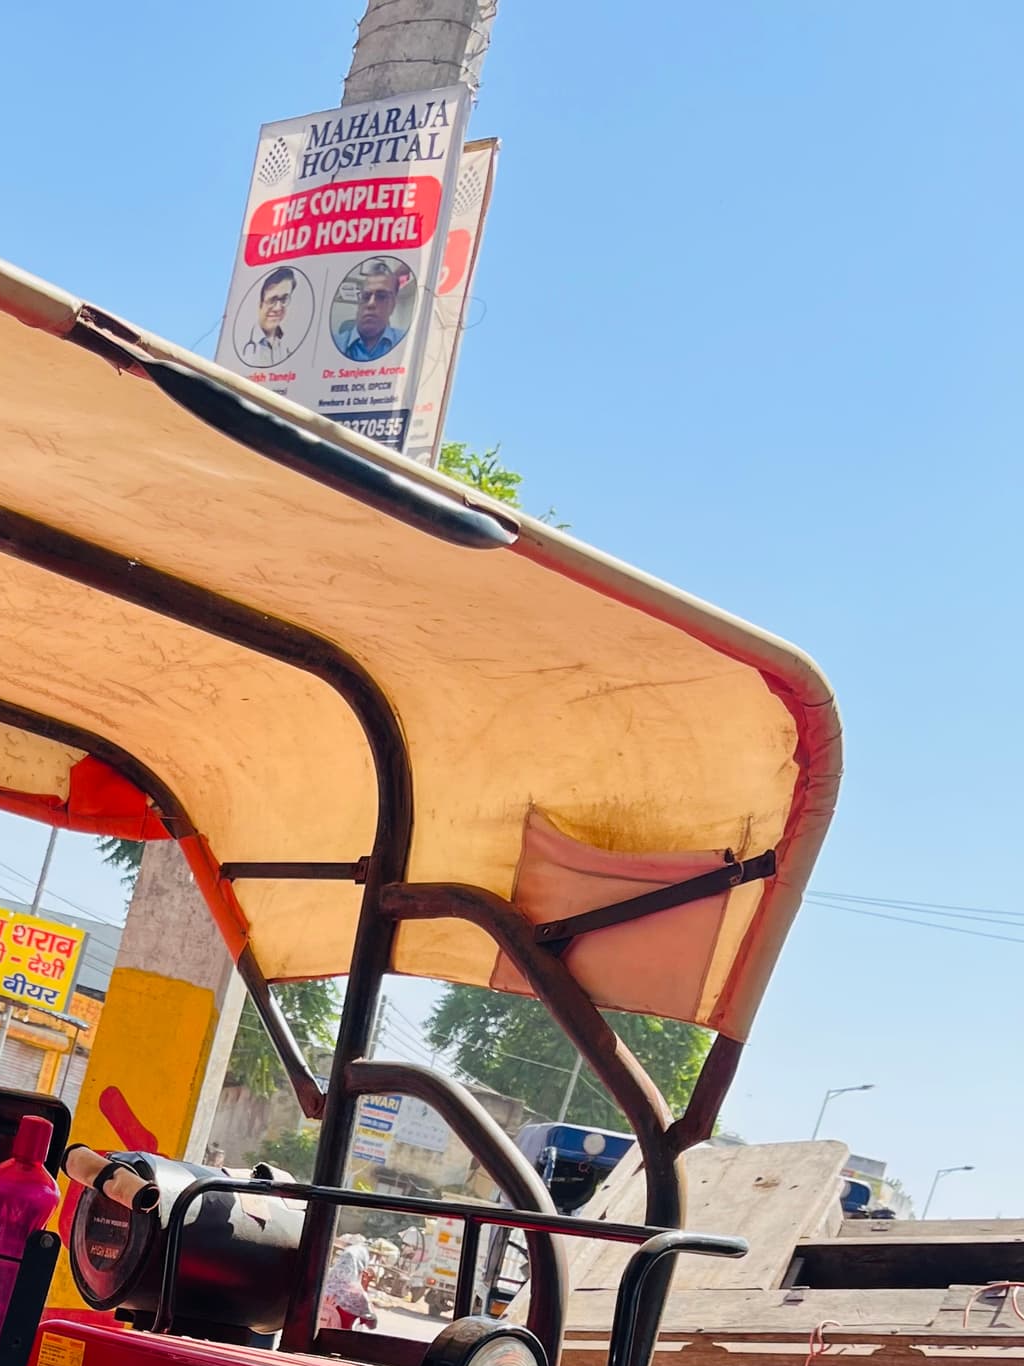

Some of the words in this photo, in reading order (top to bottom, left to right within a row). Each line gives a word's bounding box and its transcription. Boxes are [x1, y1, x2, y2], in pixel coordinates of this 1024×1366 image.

[306, 99, 449, 150] MAHARAJA
[298, 133, 445, 180] HOSPITAL
[272, 197, 304, 226] THE
[309, 183, 417, 218] COMPLETE
[258, 225, 310, 258] CHILD
[315, 215, 418, 247] HOSPITAL
[12, 923, 77, 959] शराब
[28, 952, 65, 981] देशी
[2, 973, 61, 1005] बीयर
